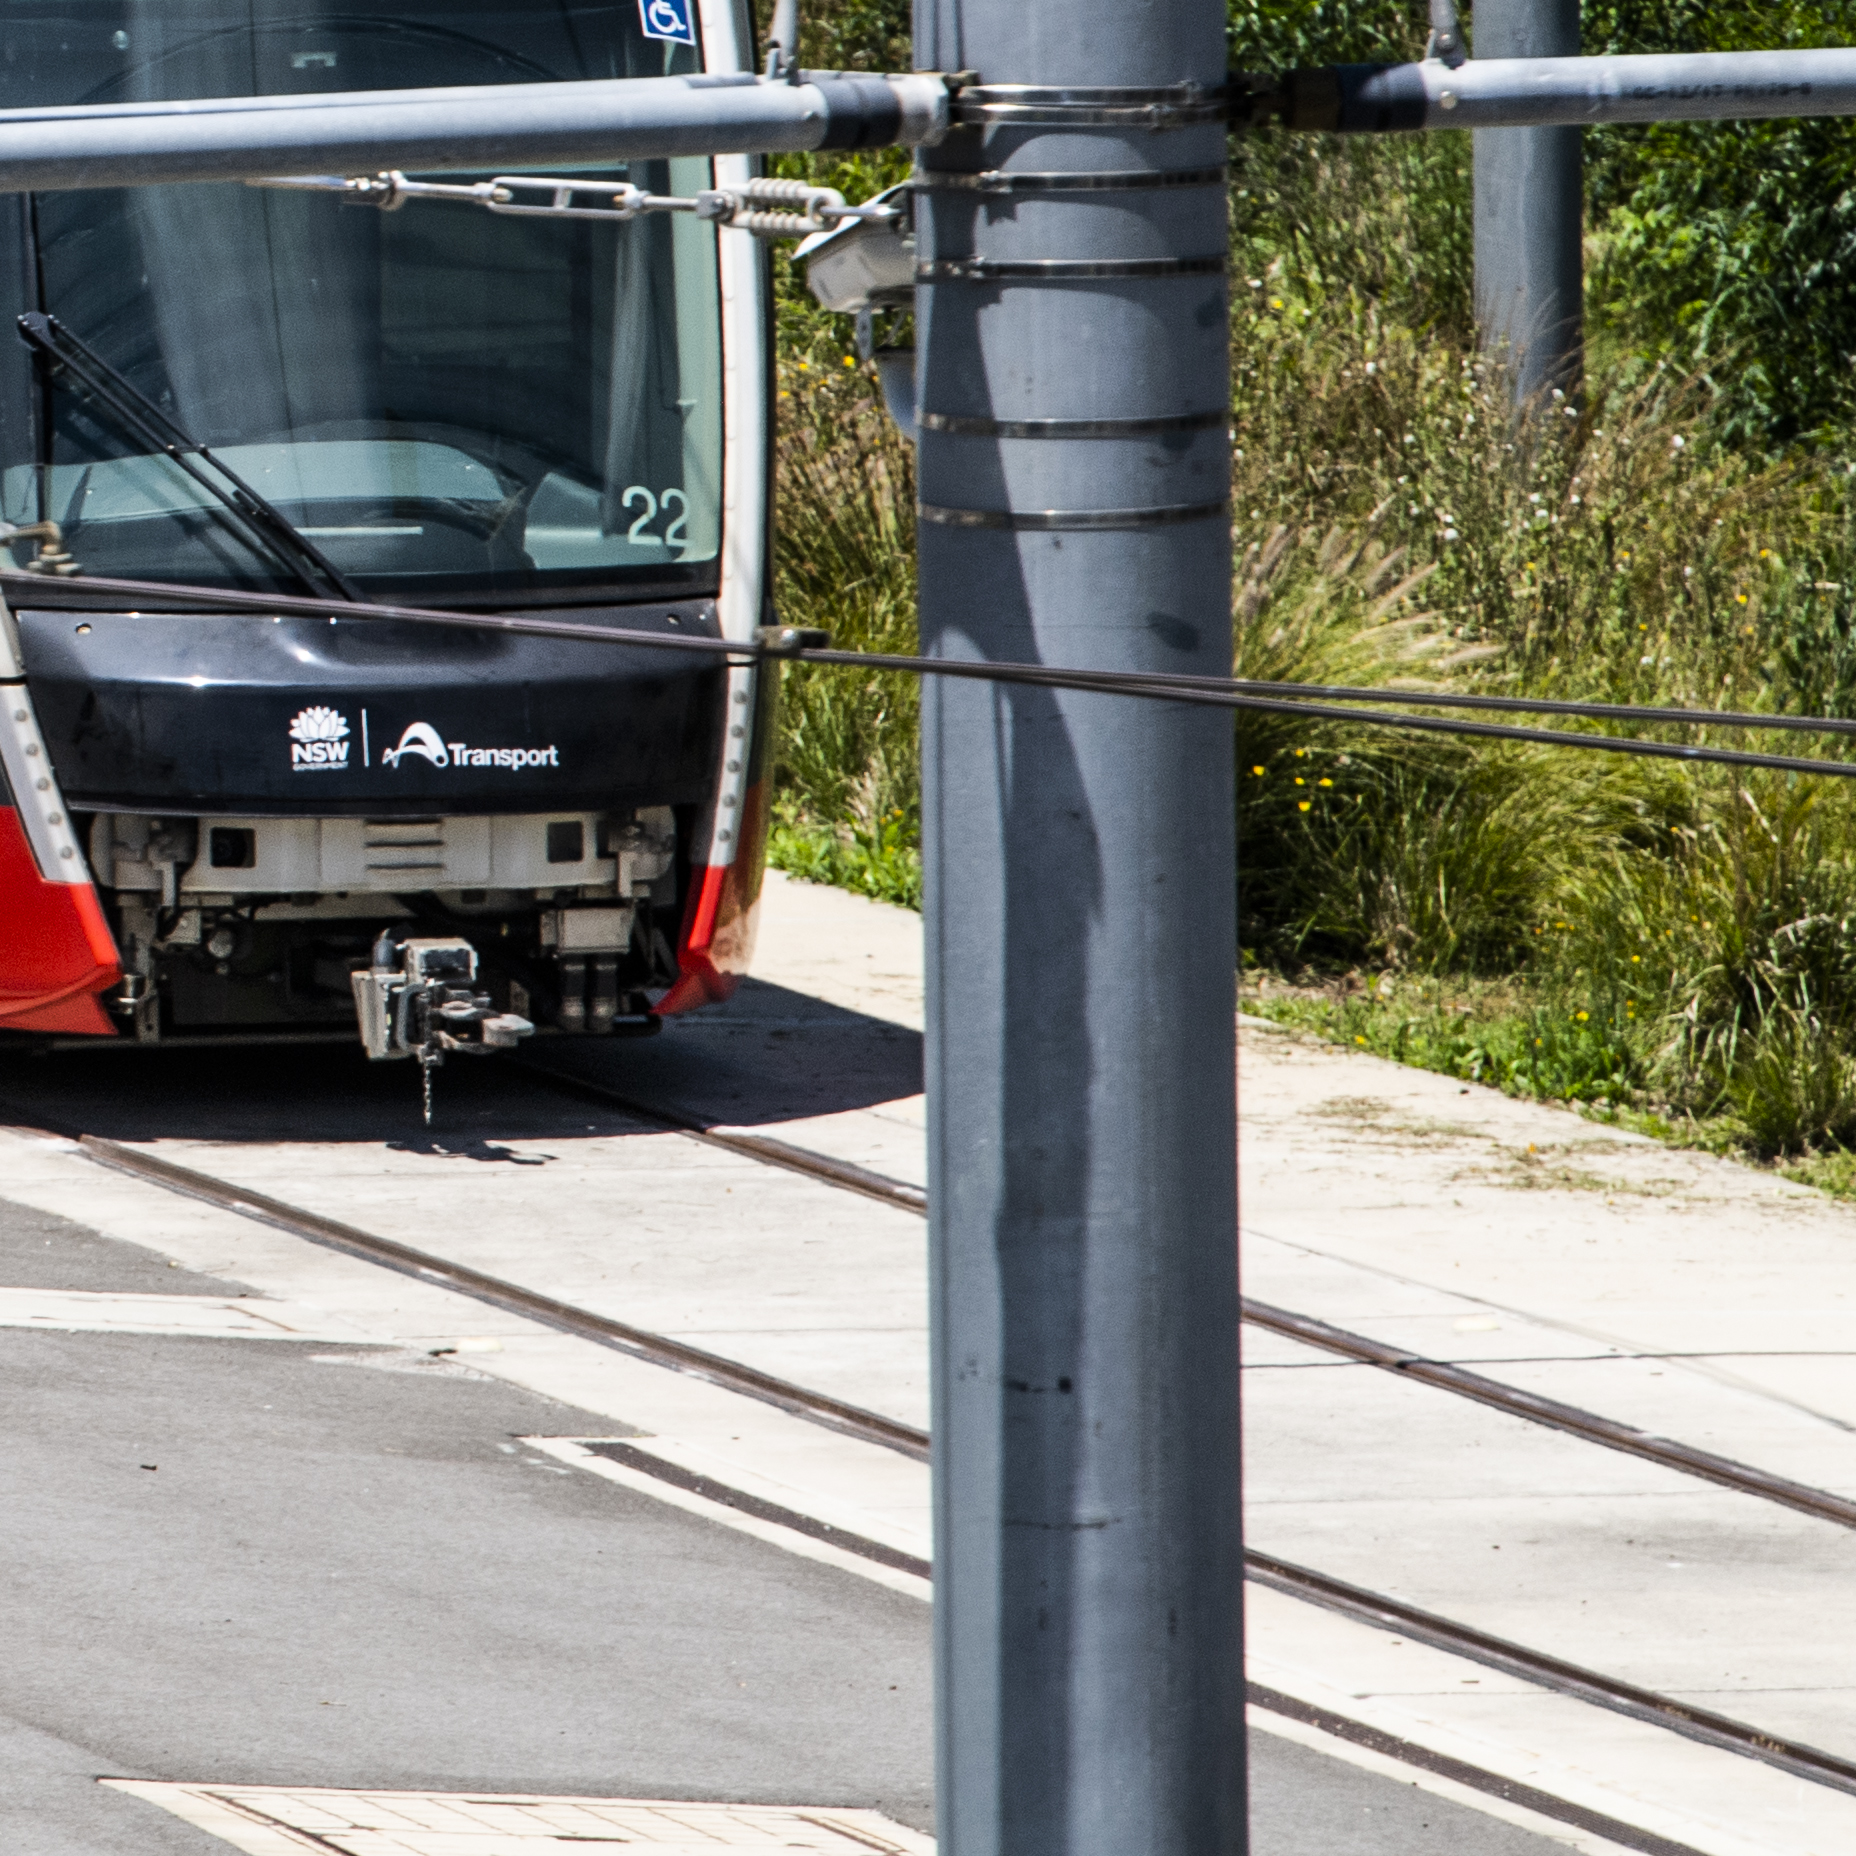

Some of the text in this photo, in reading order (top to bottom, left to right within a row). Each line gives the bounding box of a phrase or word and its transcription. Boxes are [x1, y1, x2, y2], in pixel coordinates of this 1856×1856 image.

[621, 485, 693, 548] 22
[291, 741, 350, 763] NSW
[448, 743, 559, 771] Transport
